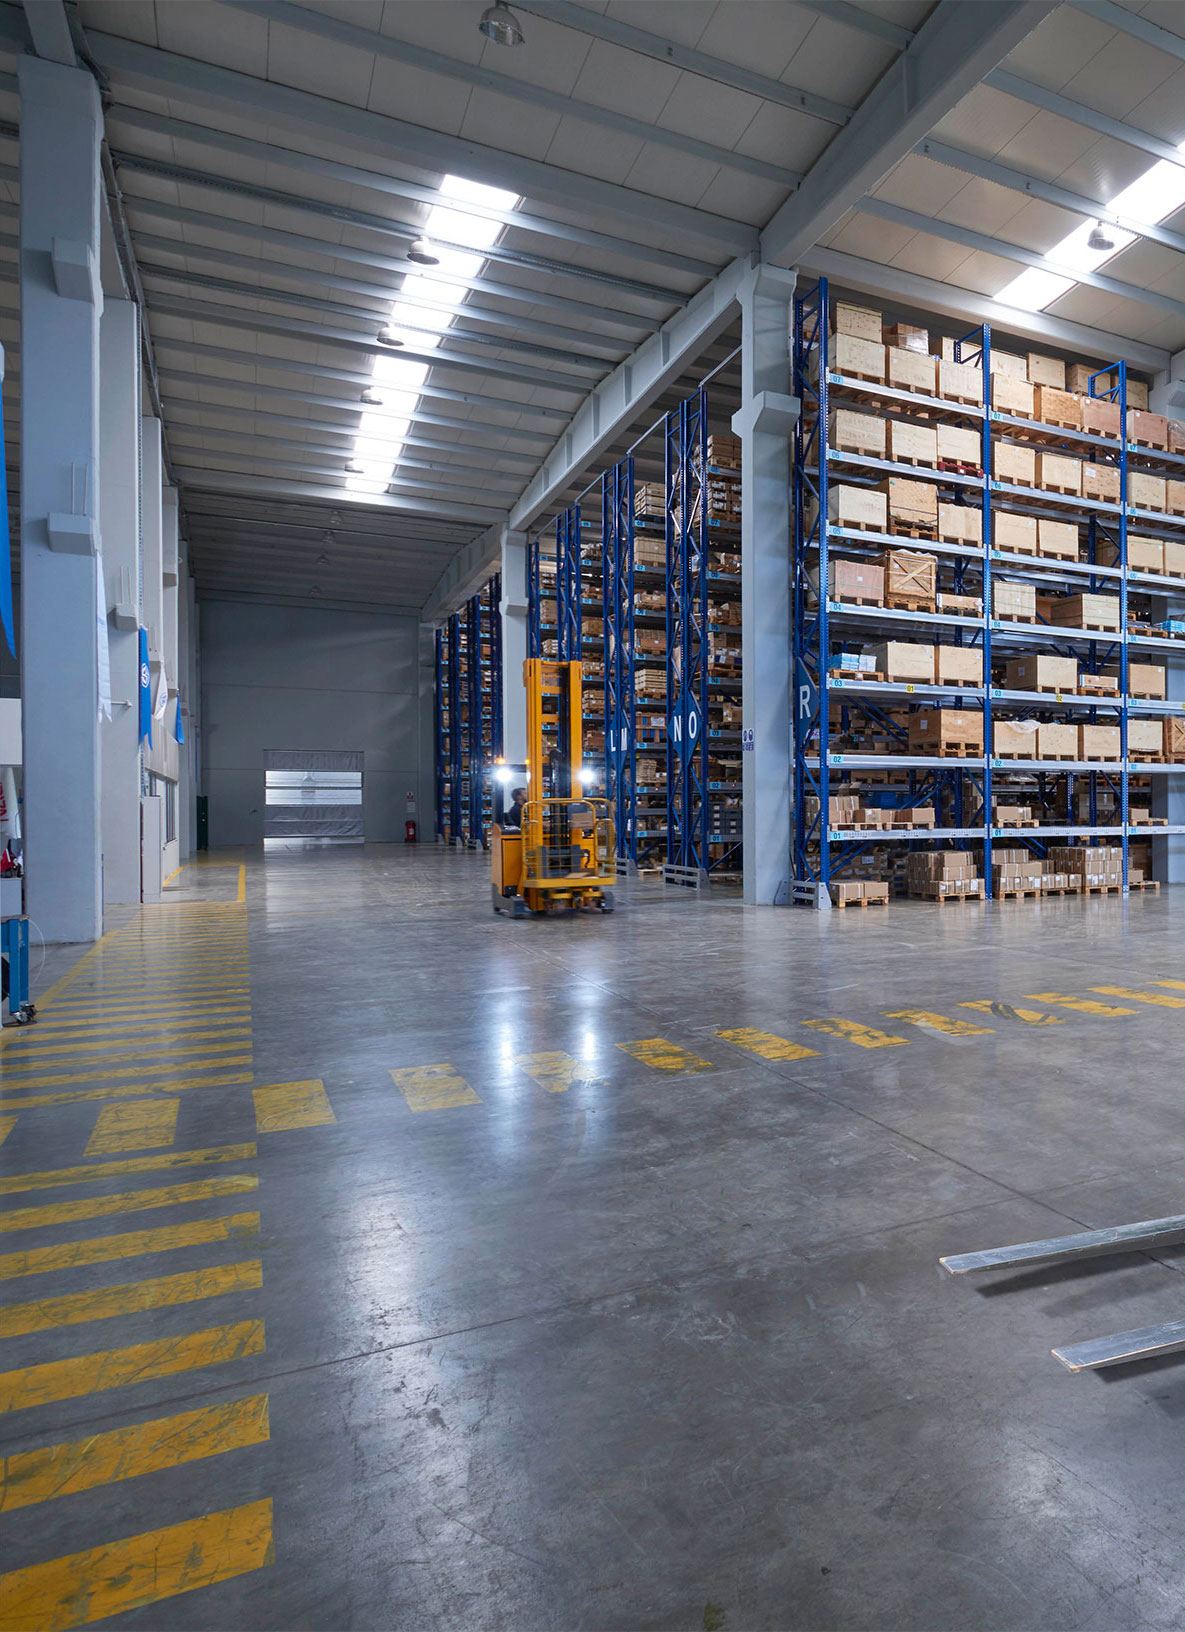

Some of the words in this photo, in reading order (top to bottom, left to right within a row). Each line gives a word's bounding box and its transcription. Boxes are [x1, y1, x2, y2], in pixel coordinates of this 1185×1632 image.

[800, 685, 811, 719] R
[673, 715, 682, 742] N
[688, 711, 697, 739] O
[610, 730, 616, 752] L
[621, 728, 627, 751] M
